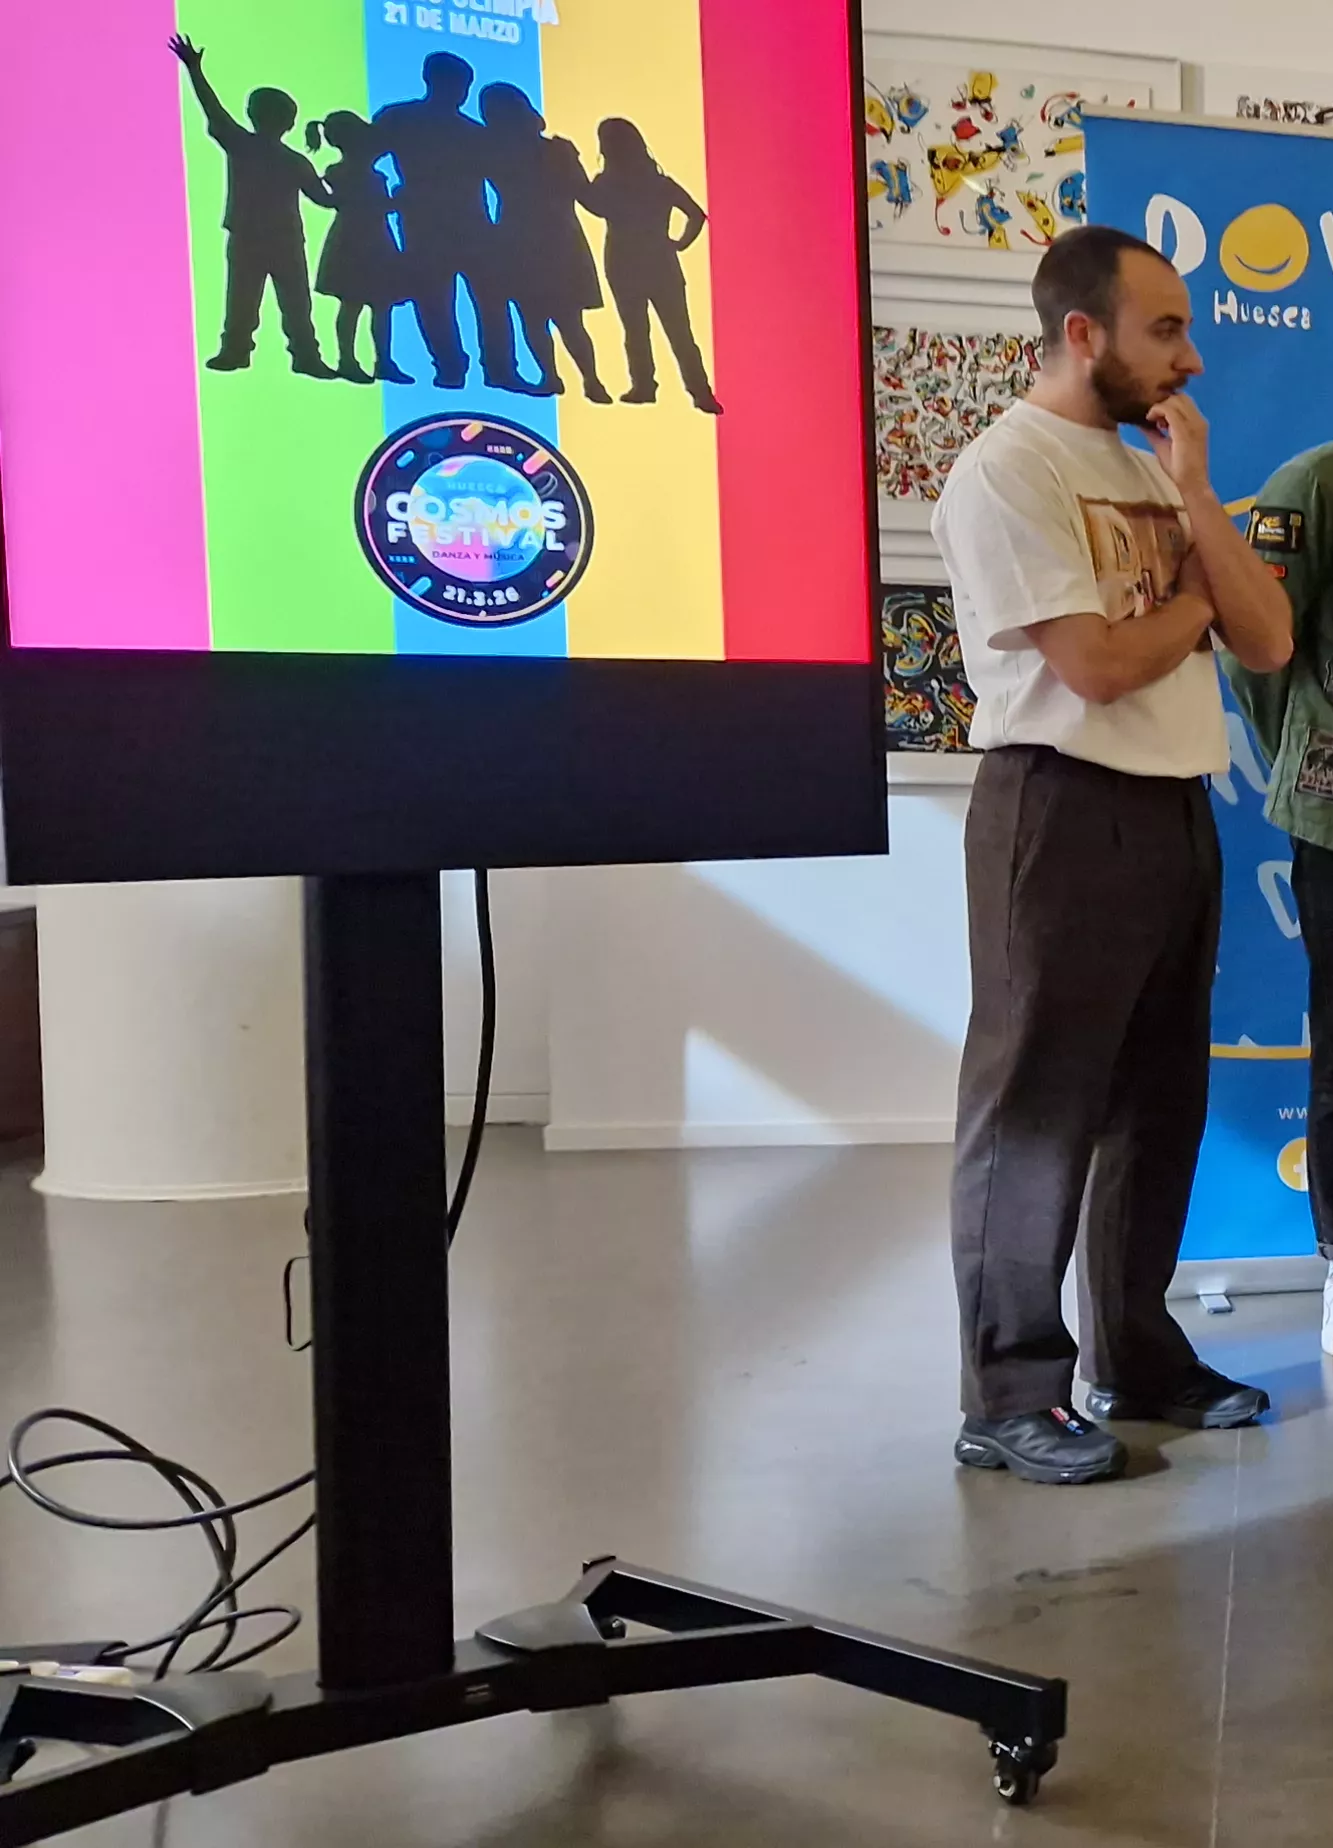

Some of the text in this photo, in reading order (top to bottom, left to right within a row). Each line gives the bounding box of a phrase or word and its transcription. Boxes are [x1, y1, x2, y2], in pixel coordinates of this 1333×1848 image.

[384, 1, 521, 45] 21 DE MARZO
[1214, 289, 1312, 330] Huesca
[386, 491, 567, 530] COSMOS
[387, 521, 566, 552] FESTIVAL
[432, 550, 471, 560] DANZA
[474, 552, 481, 560] Y
[442, 585, 519, 606] 21.3.26
